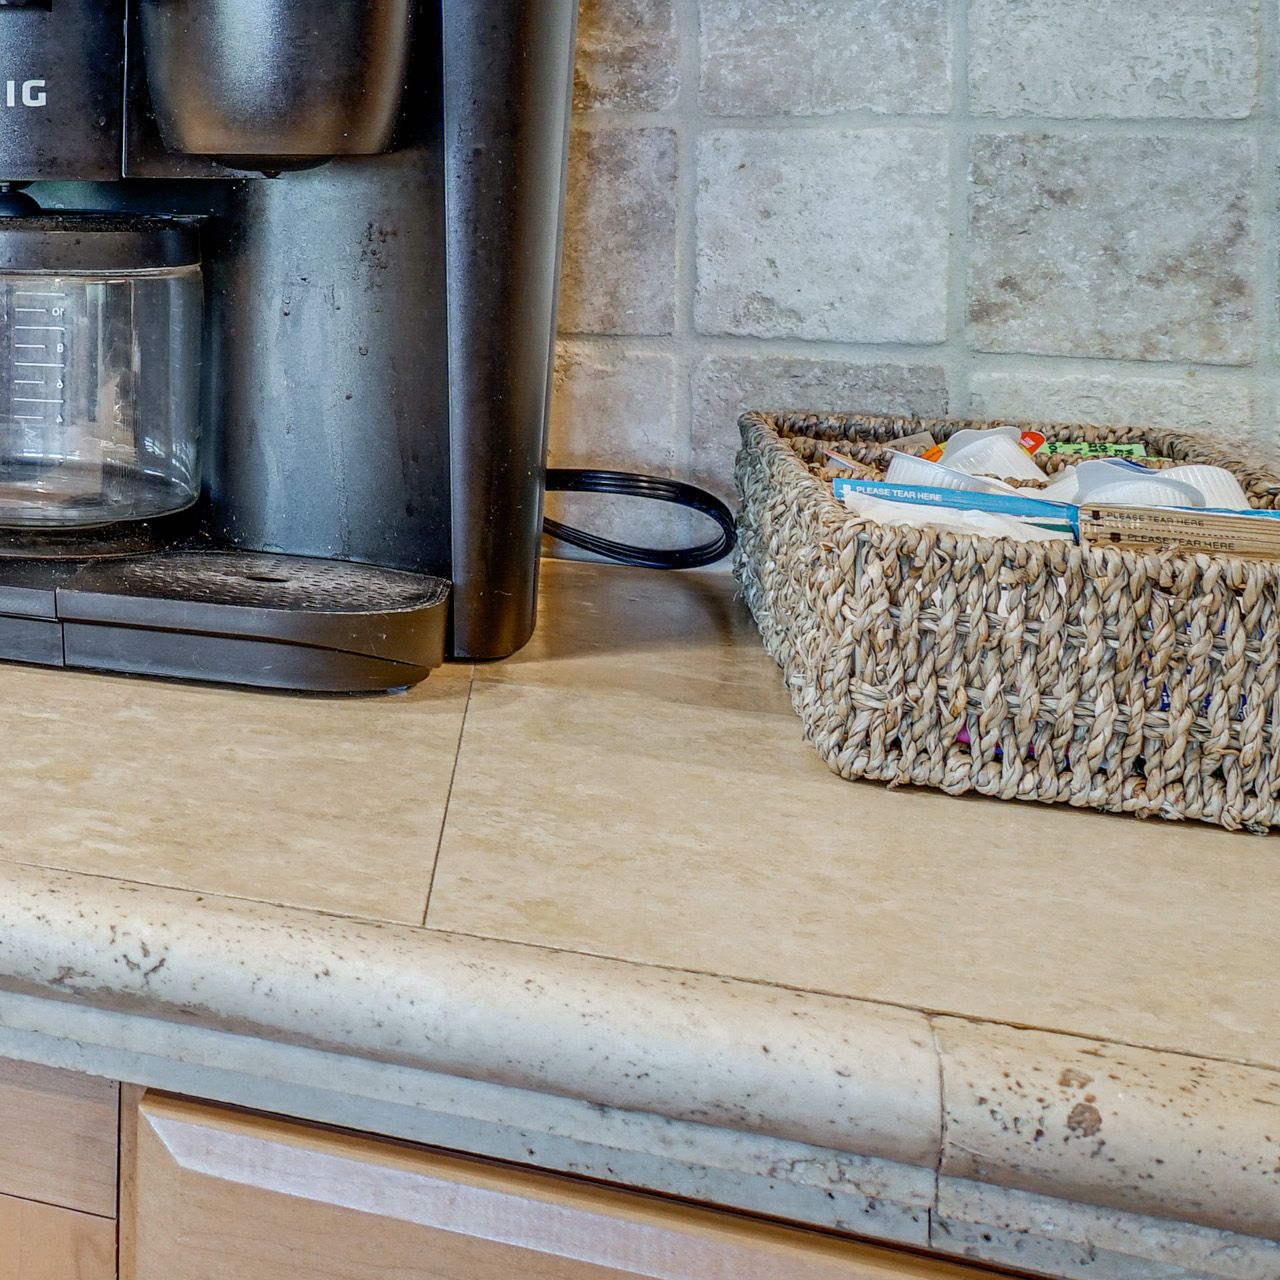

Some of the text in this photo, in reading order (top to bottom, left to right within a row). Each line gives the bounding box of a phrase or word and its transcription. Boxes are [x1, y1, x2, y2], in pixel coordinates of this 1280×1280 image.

[856, 486, 943, 501] PLEASE TEAR HERE
[1106, 511, 1205, 527] PLEASE TEAR HERE
[1127, 533, 1235, 550] PLEASE TEAR HERE
